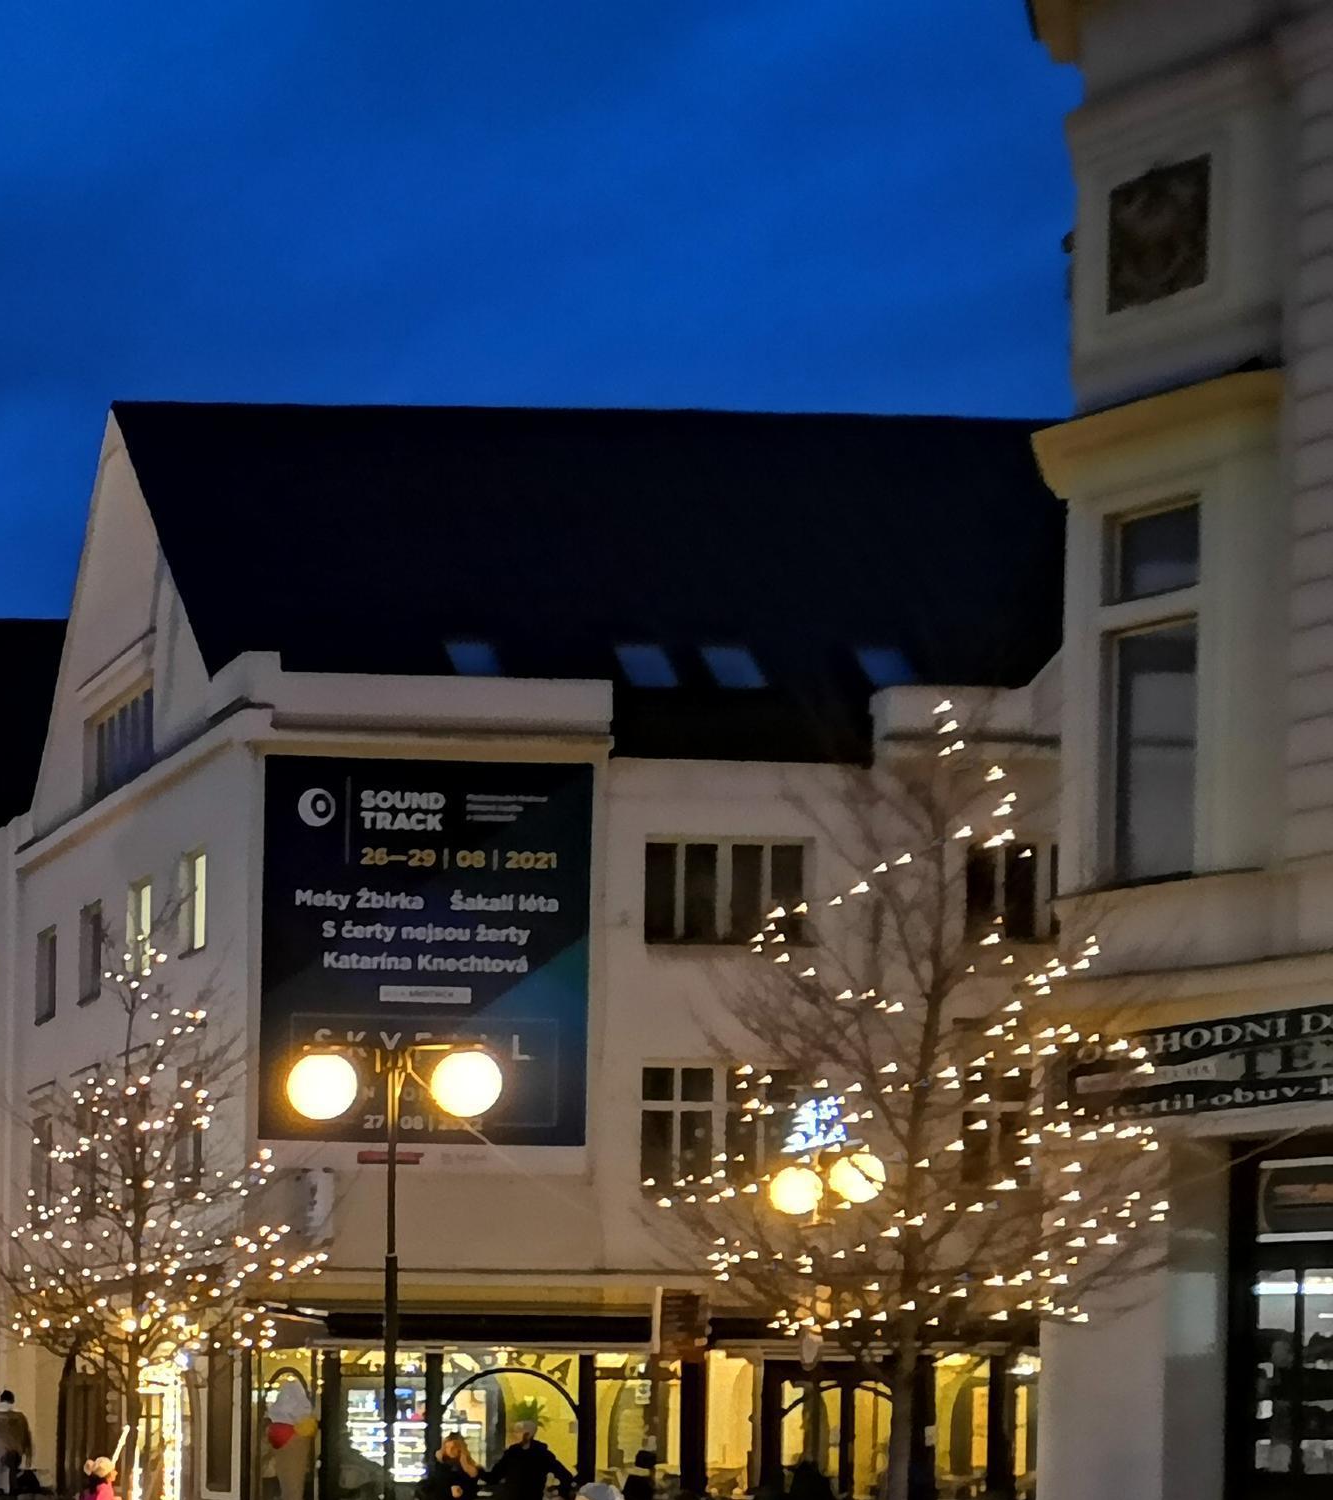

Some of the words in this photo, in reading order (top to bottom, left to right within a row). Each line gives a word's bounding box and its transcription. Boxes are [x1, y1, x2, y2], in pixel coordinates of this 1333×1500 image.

[360, 790, 446, 810] SOUND
[360, 811, 444, 831] TRACK
[456, 849, 486, 869] 08
[504, 850, 558, 870] 2021
[294, 888, 352, 911] Meky
[321, 919, 336, 939] S
[340, 920, 397, 943] čerty
[400, 922, 471, 944] nejsou
[475, 923, 531, 946] žerty
